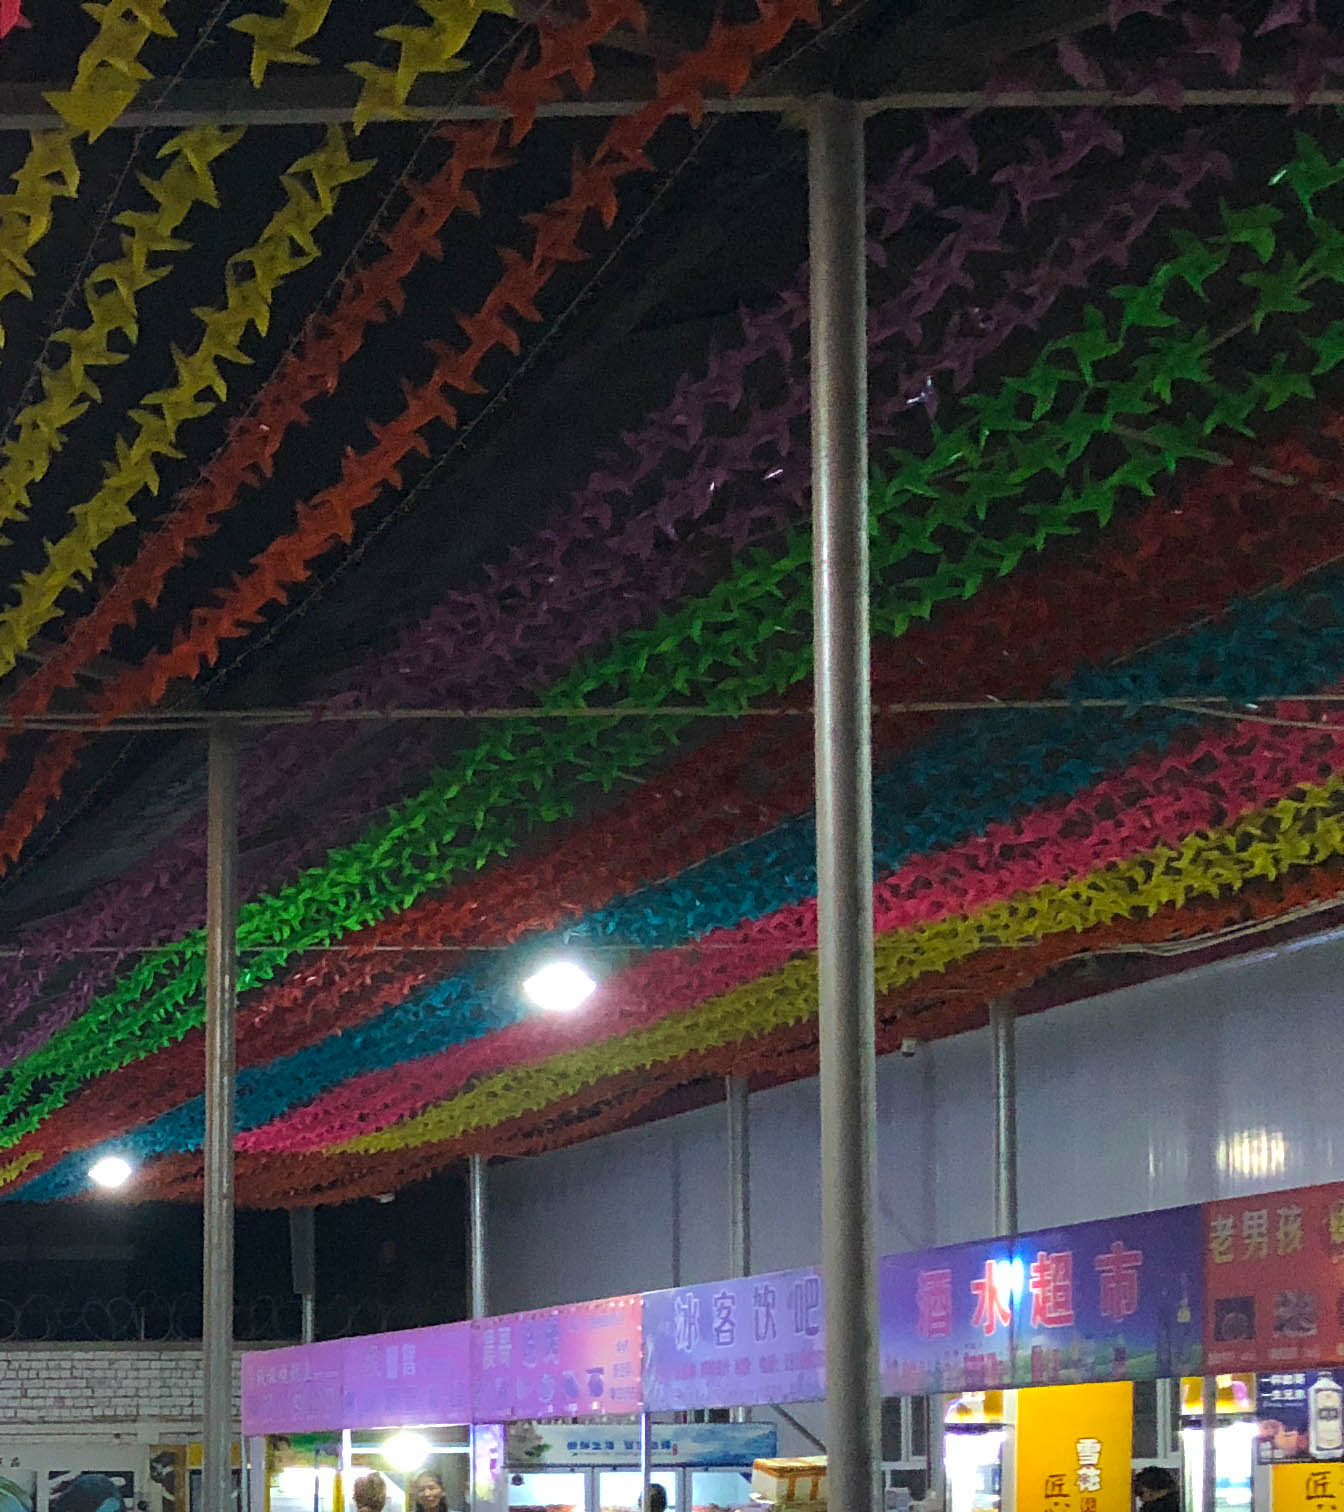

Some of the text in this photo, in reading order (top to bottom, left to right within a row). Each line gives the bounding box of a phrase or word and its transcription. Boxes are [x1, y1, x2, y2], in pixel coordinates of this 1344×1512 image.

[1210, 1206, 1304, 1264] 老男孩
[916, 1241, 1144, 1340] 酒水超市
[1076, 1438, 1102, 1492] 雪花
